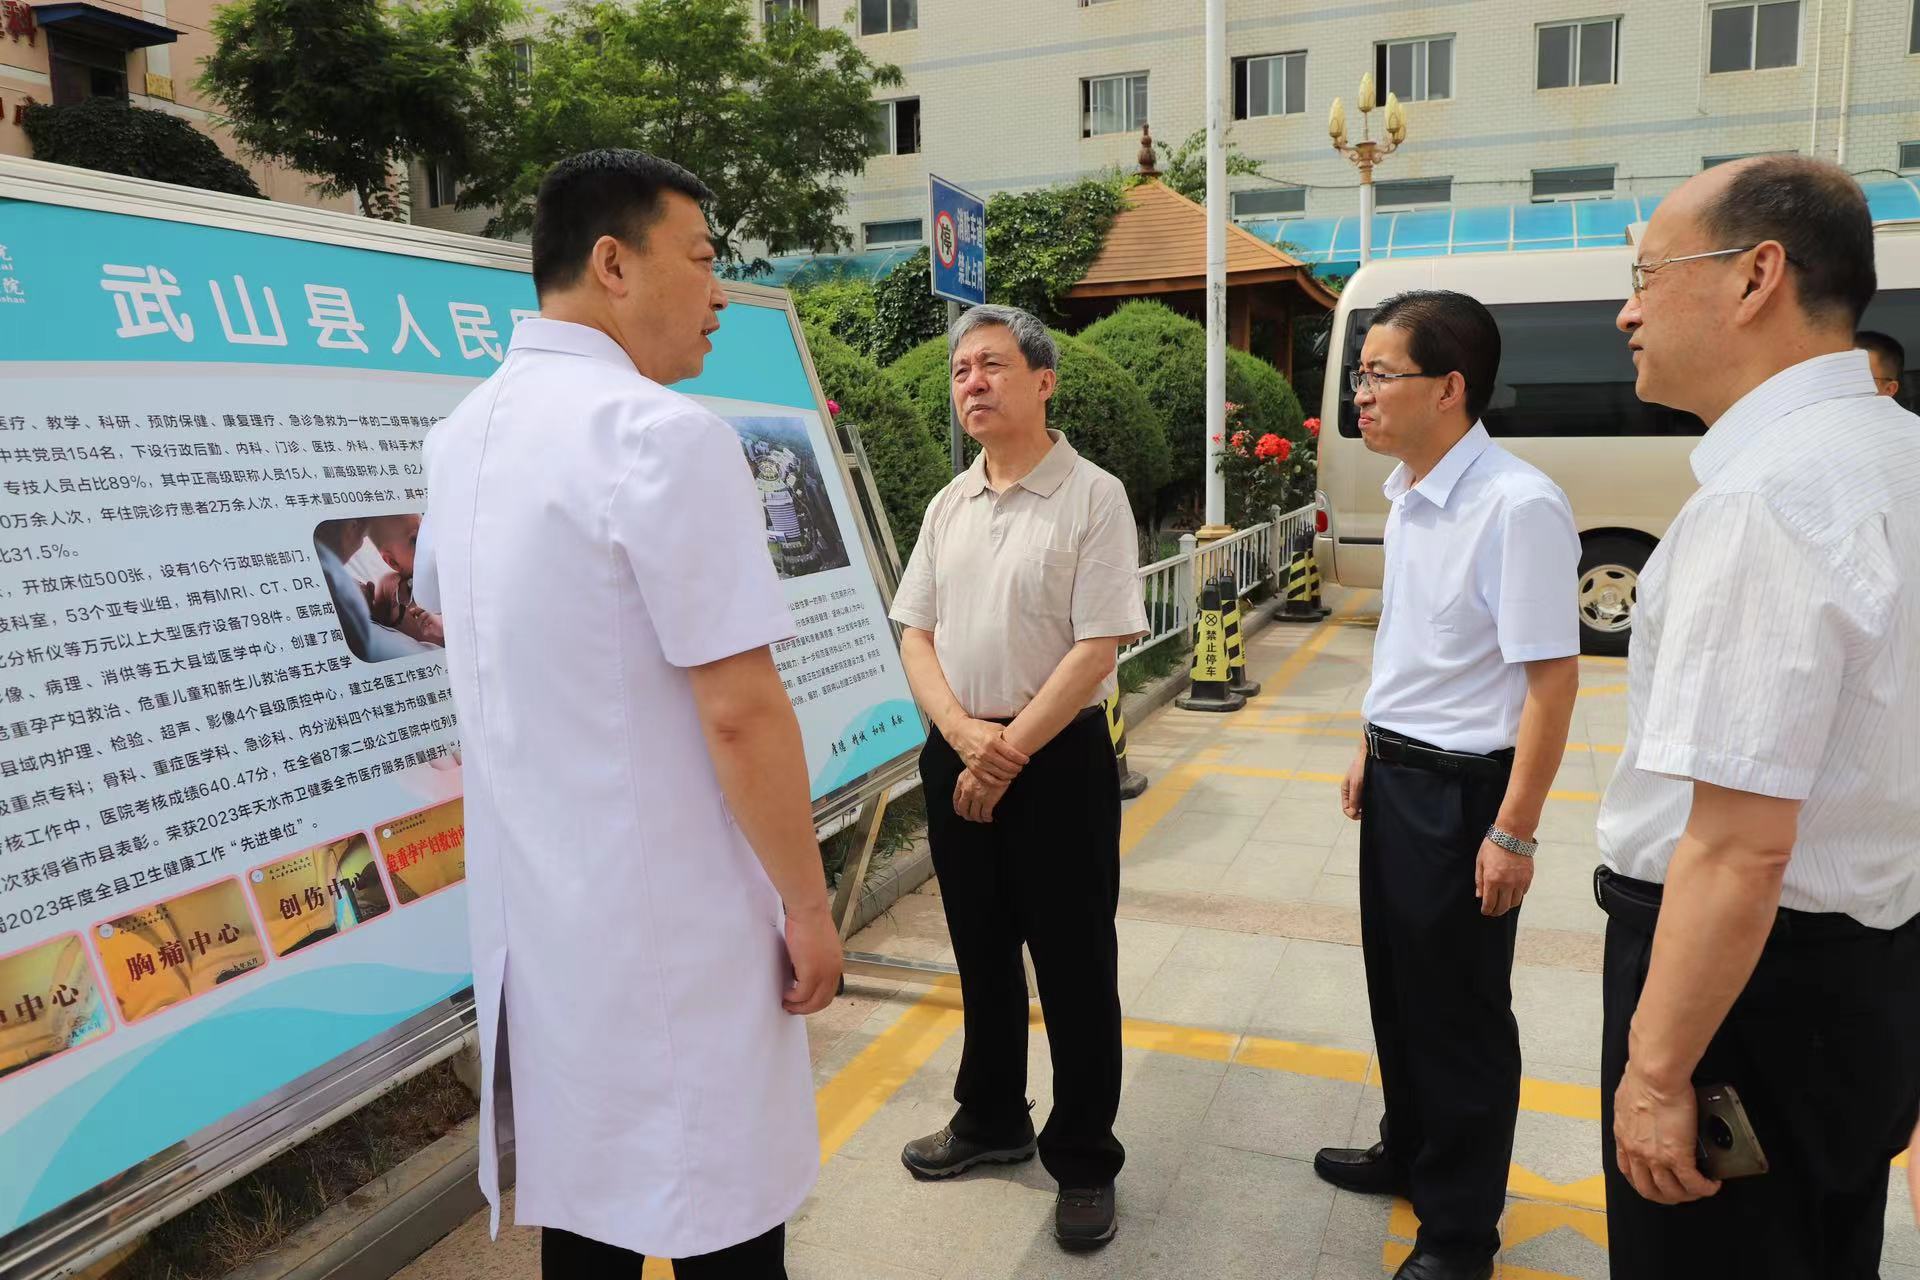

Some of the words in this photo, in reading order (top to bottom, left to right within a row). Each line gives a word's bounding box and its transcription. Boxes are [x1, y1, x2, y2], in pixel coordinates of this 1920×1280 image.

[941, 222, 952, 256] 停
[0, 413, 447, 431] 医疗、教学、科研、预防保健、康复理疗、急诊急救为一体的二级甲等综合
[0, 629, 344, 704] 像、病理、消供等五大县域医学中心，创建了胸
[1205, 629, 1217, 677] 禁止停车
[0, 714, 457, 855] 核工作中，医院考核成绩640.47分，在全省87家二级公立医院中位列
[126, 923, 240, 982] 胸痛中心
[0, 984, 79, 1024] 中心
